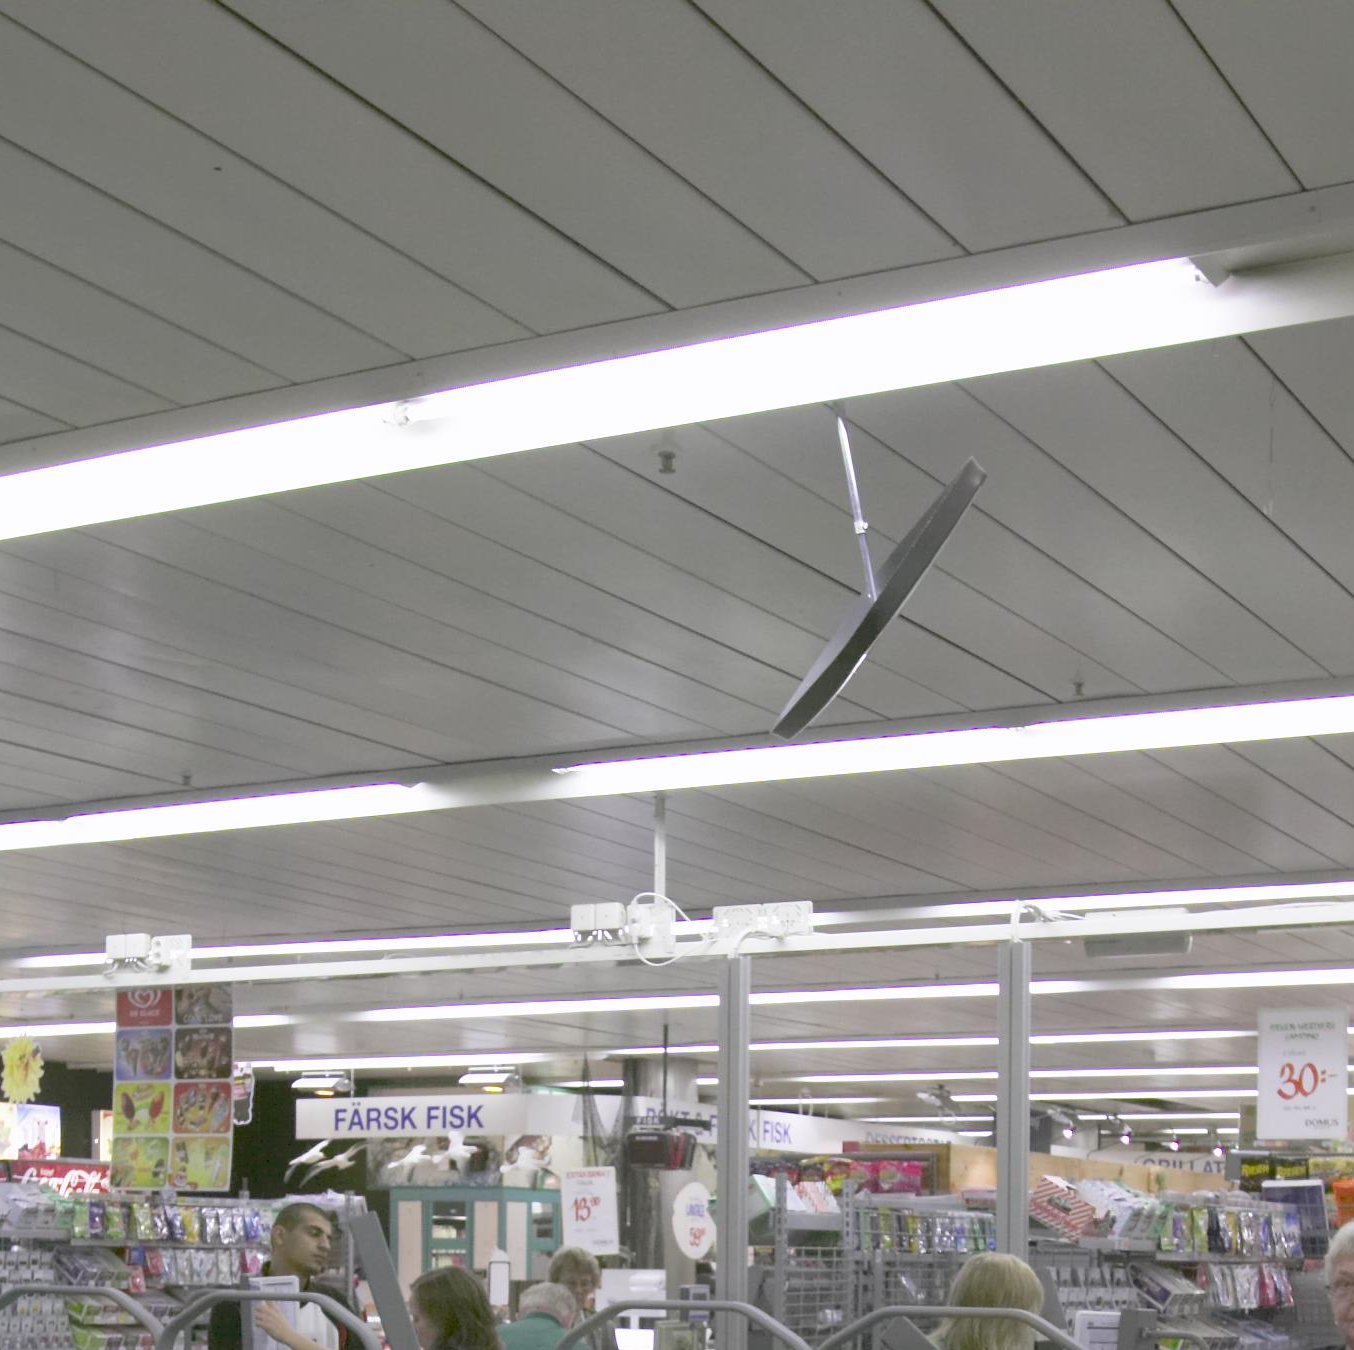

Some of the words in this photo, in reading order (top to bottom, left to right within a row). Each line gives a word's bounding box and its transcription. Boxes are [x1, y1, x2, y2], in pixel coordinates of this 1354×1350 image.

[333, 1102, 417, 1131] FÄRSK
[426, 1104, 484, 1129] FISK
[762, 1122, 793, 1145] FISK
